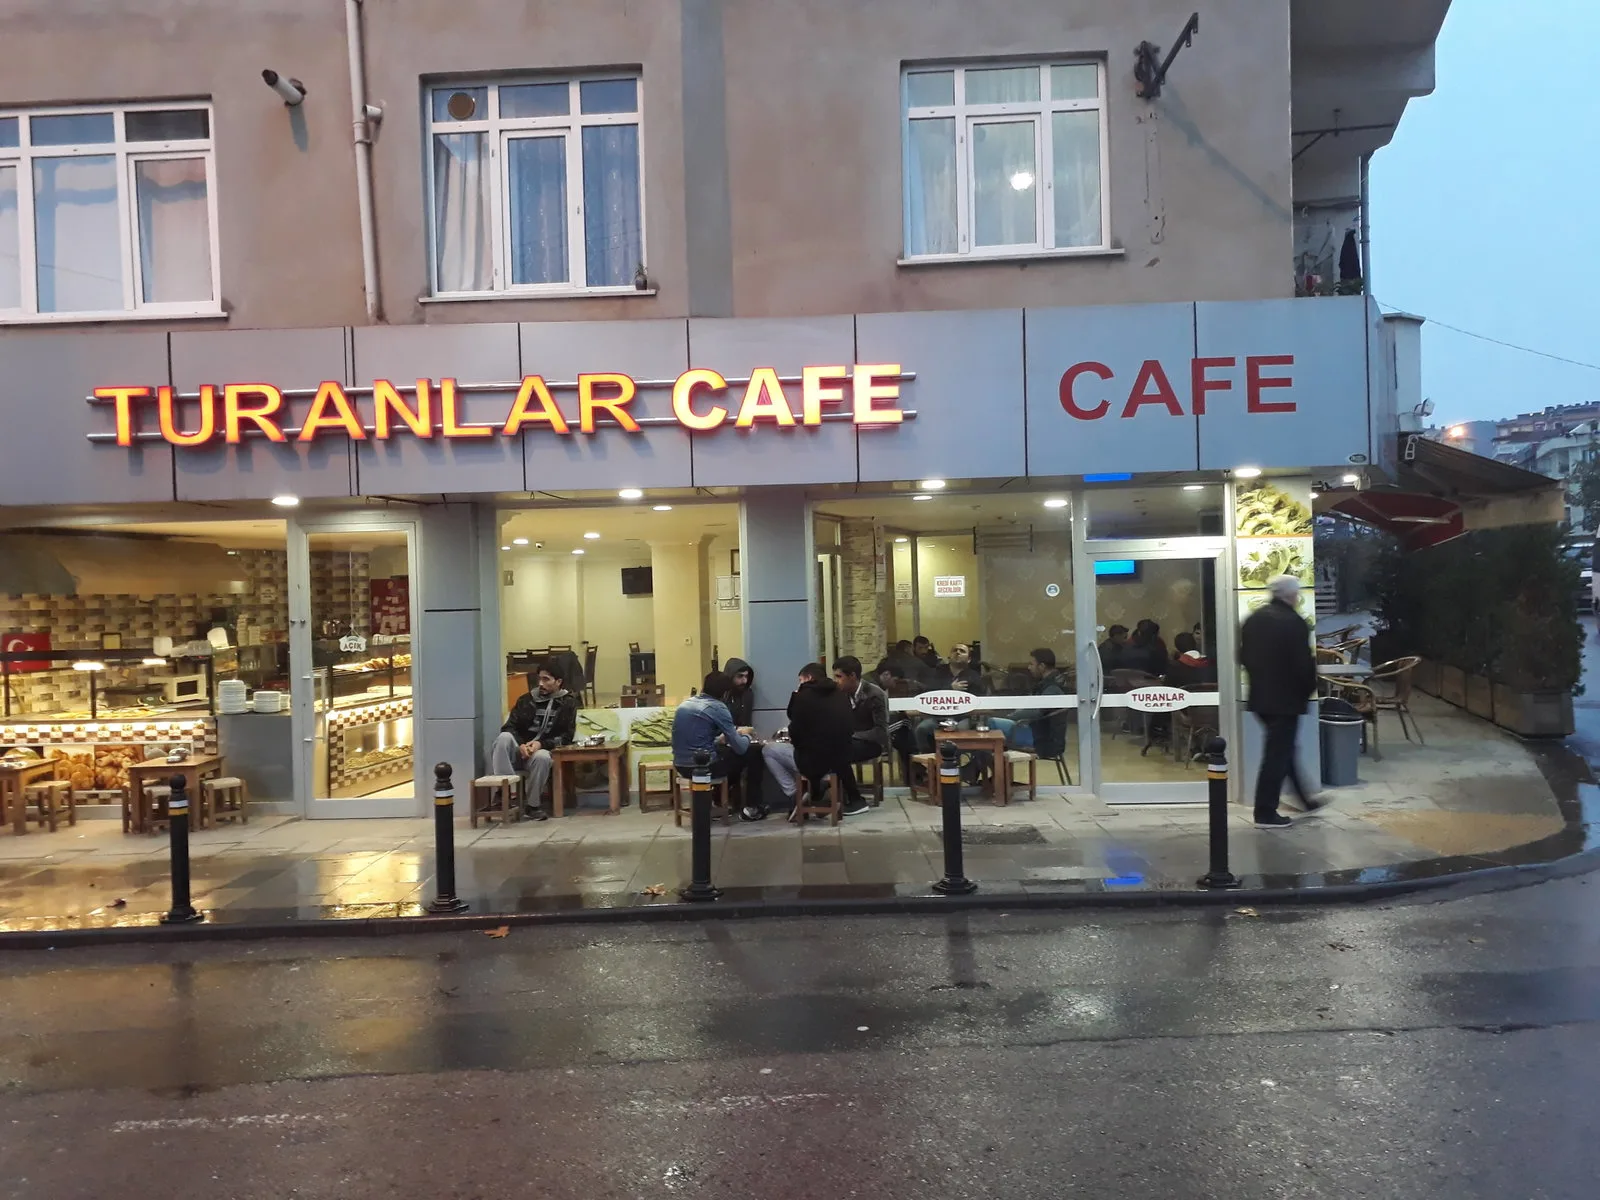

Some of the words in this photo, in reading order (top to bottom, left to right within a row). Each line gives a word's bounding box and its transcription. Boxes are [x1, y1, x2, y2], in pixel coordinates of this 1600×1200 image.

[93, 372, 643, 447] TURANLAR
[671, 363, 904, 431] CAFE
[1058, 354, 1298, 420] CAFE
[919, 696, 971, 705] TURANLAR
[1131, 693, 1185, 702] TURANLAR
